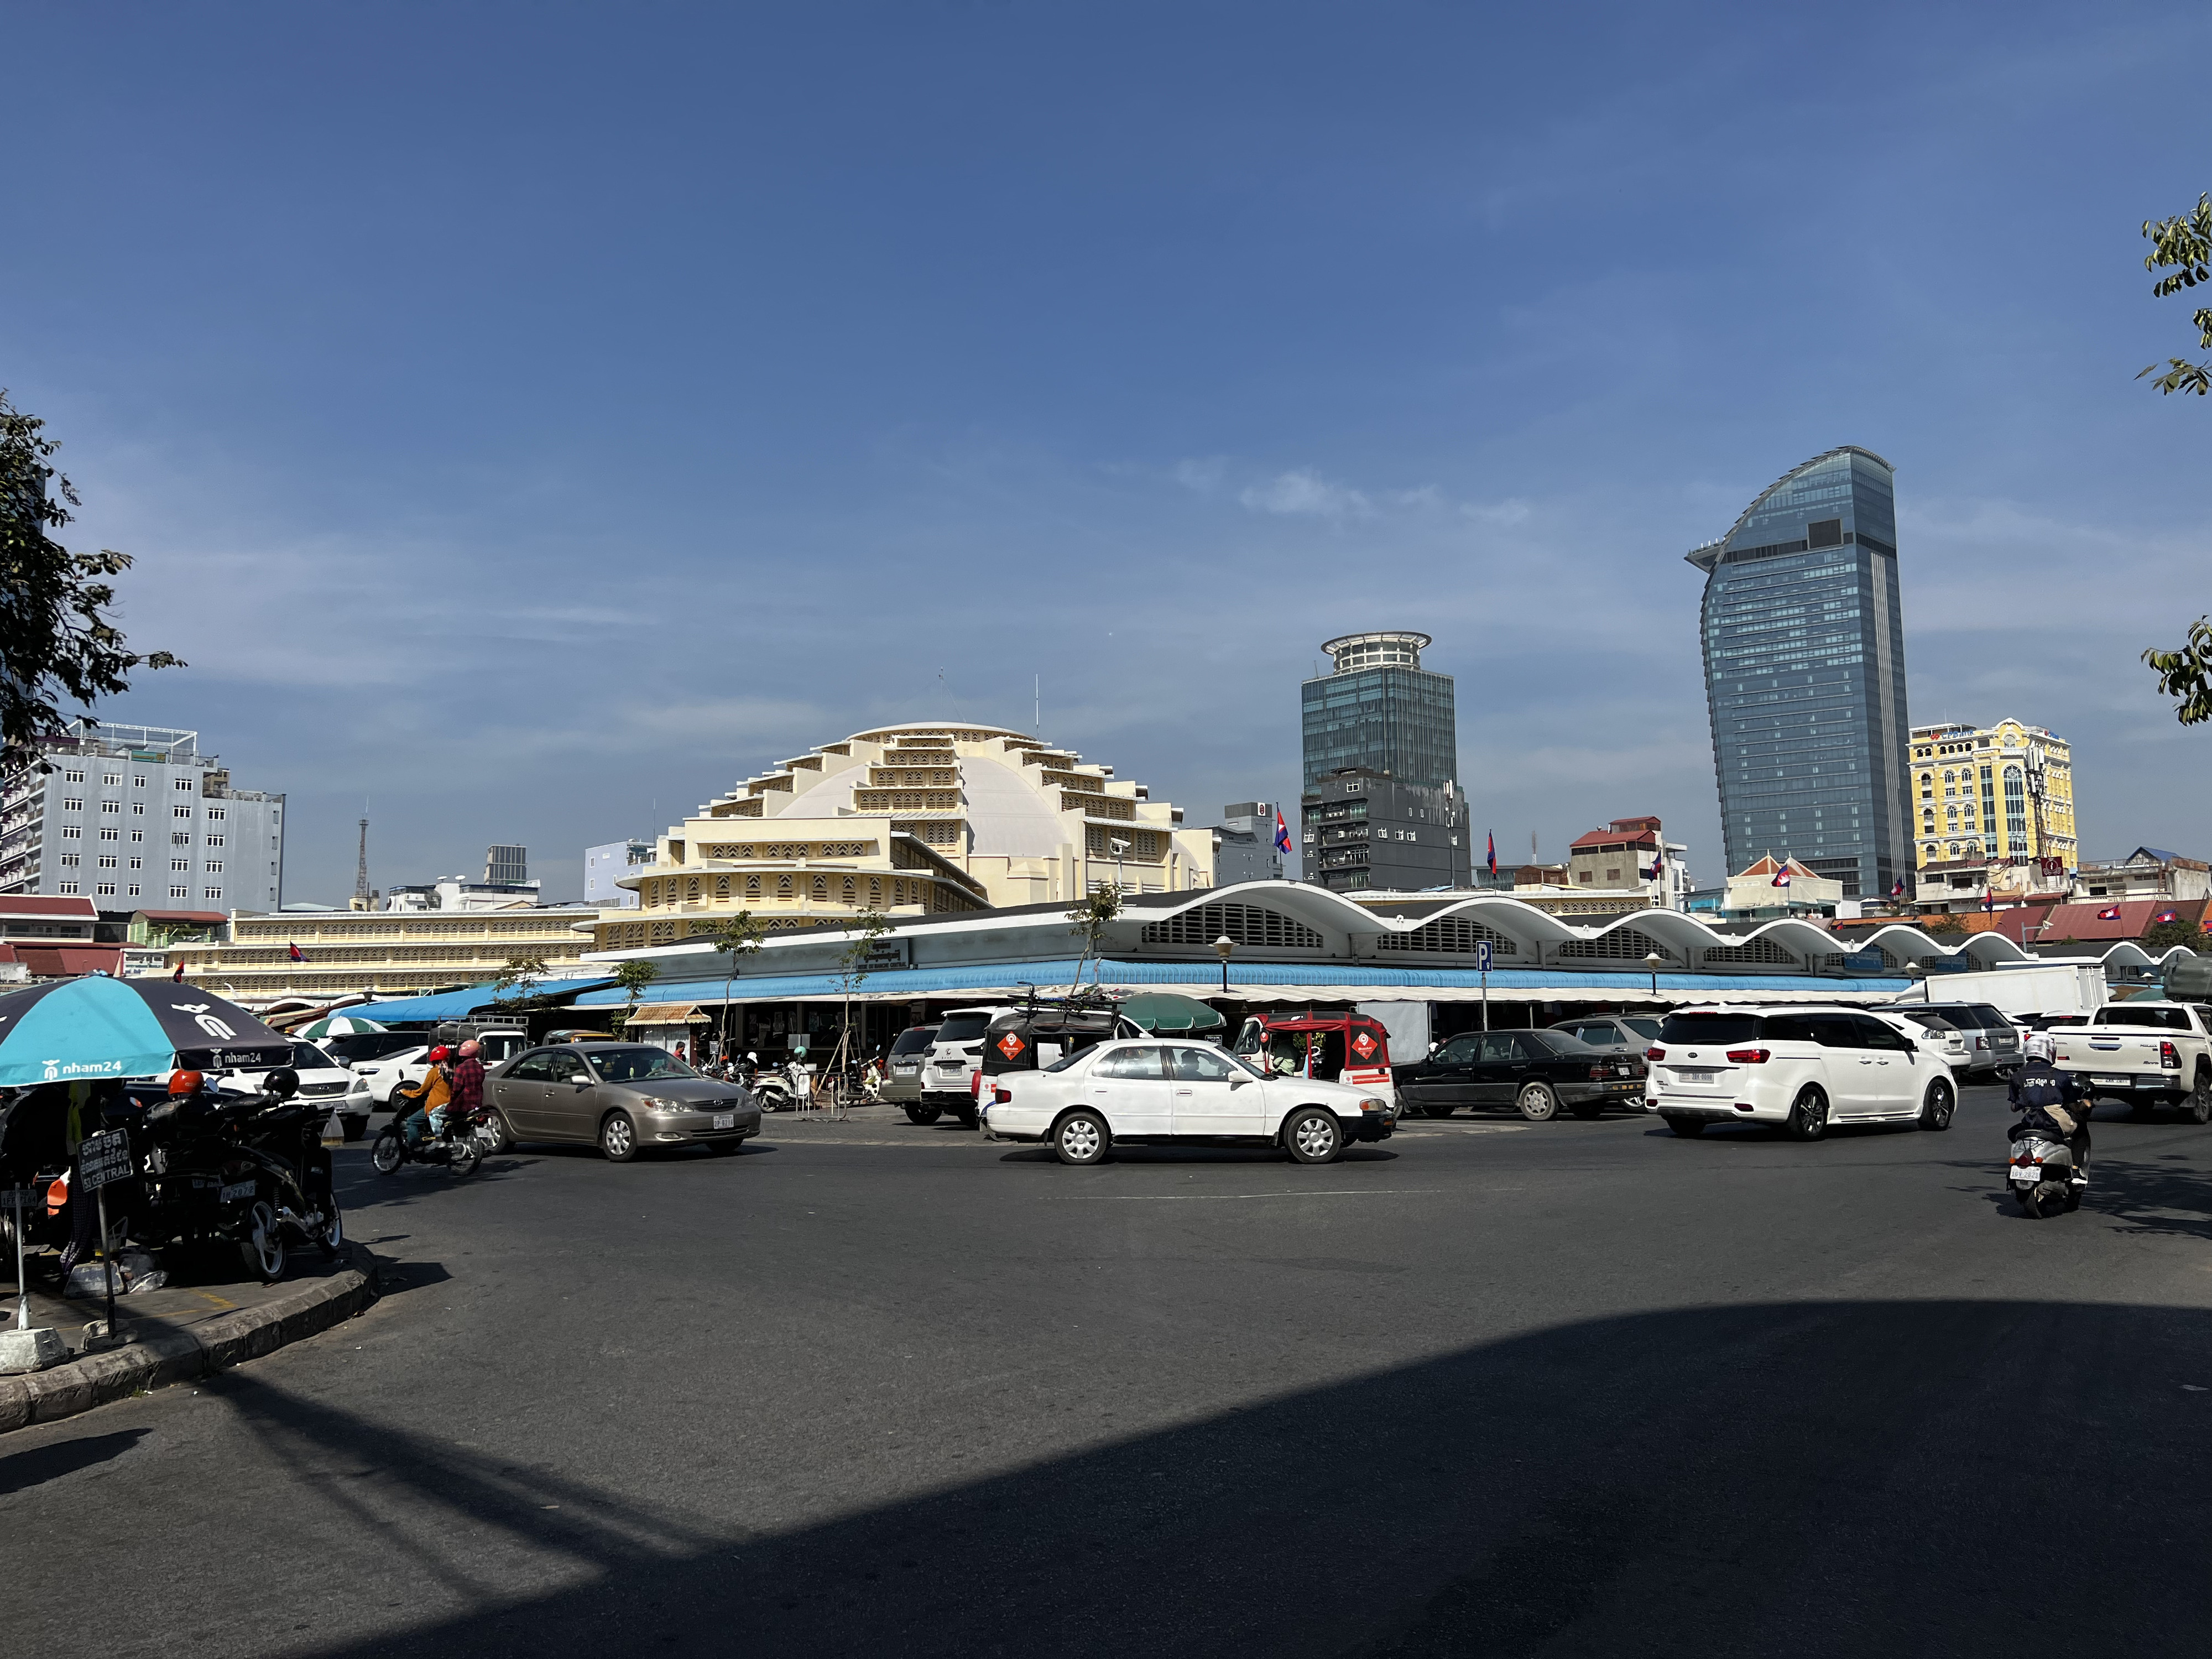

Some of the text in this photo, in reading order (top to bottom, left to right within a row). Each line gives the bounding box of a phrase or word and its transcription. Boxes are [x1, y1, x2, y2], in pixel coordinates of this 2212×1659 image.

[1479, 943, 1488, 970] P
[225, 1052, 262, 1063] nham24
[62, 1061, 122, 1074] nham24
[92, 1164, 131, 1185] CENTRAL
